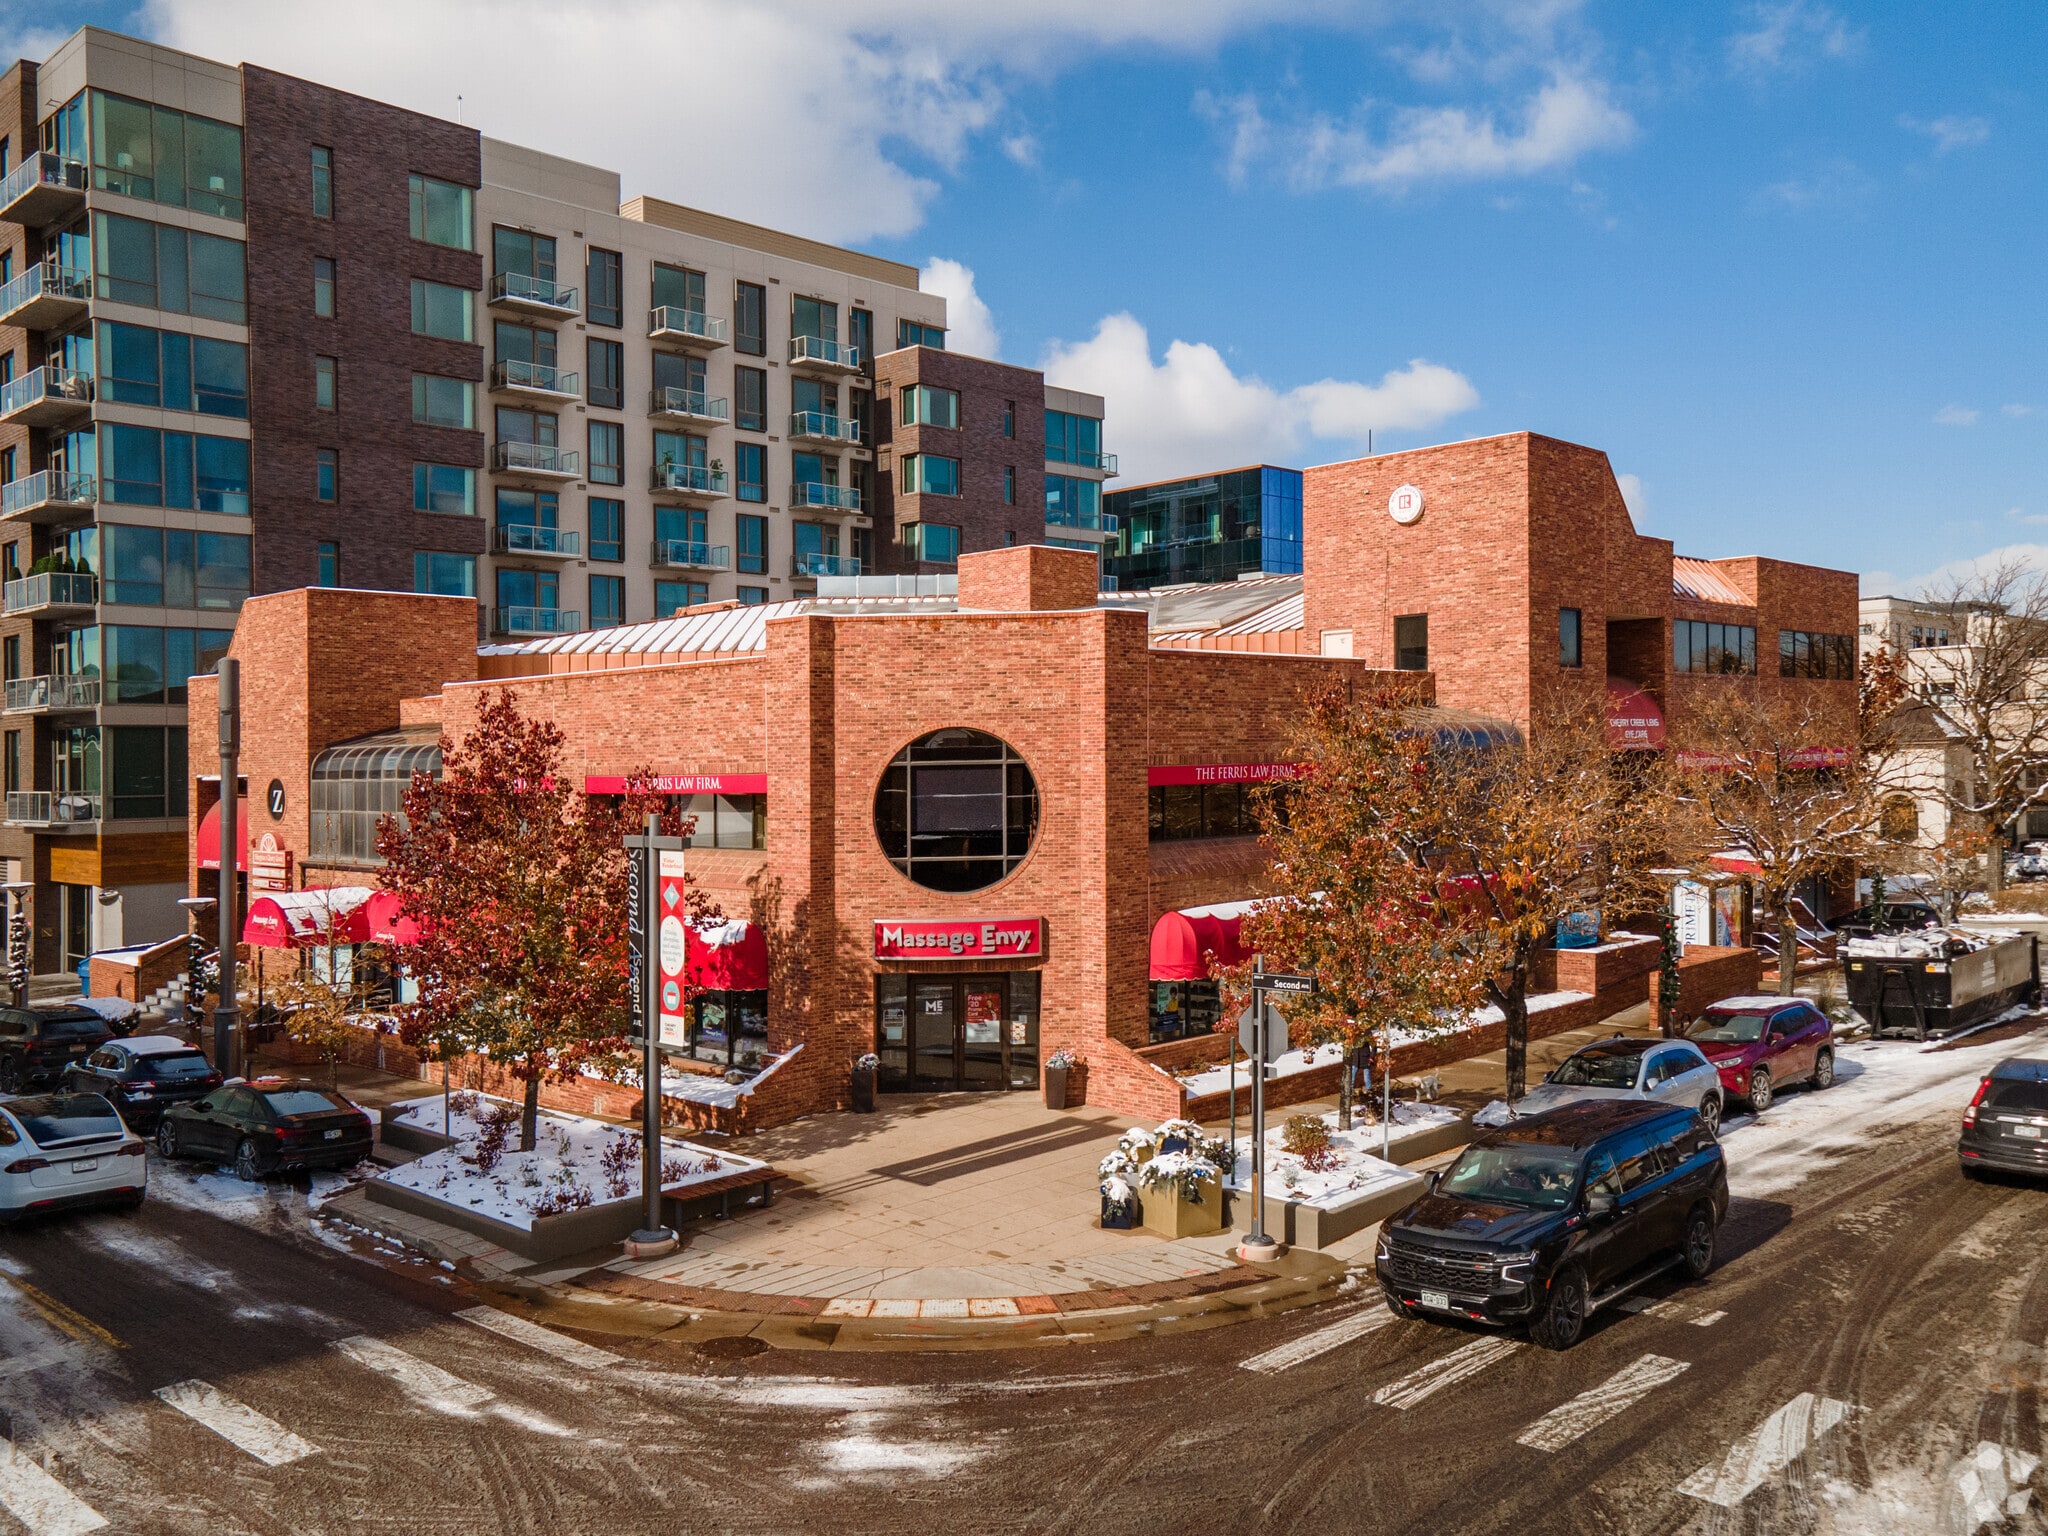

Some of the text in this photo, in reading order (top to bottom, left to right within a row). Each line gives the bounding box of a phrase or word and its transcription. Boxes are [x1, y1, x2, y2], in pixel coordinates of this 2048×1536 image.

[675, 777, 694, 790] LAW
[696, 776, 722, 790] FIRM.
[1196, 767, 1215, 780] THE
[1218, 766, 1248, 779] FERRIS
[1250, 765, 1270, 778] LAW
[272, 789, 283, 814] Z
[629, 849, 644, 936] Second
[882, 926, 975, 954] Massage
[633, 955, 642, 1014] Second
[1274, 979, 1301, 990] Second
